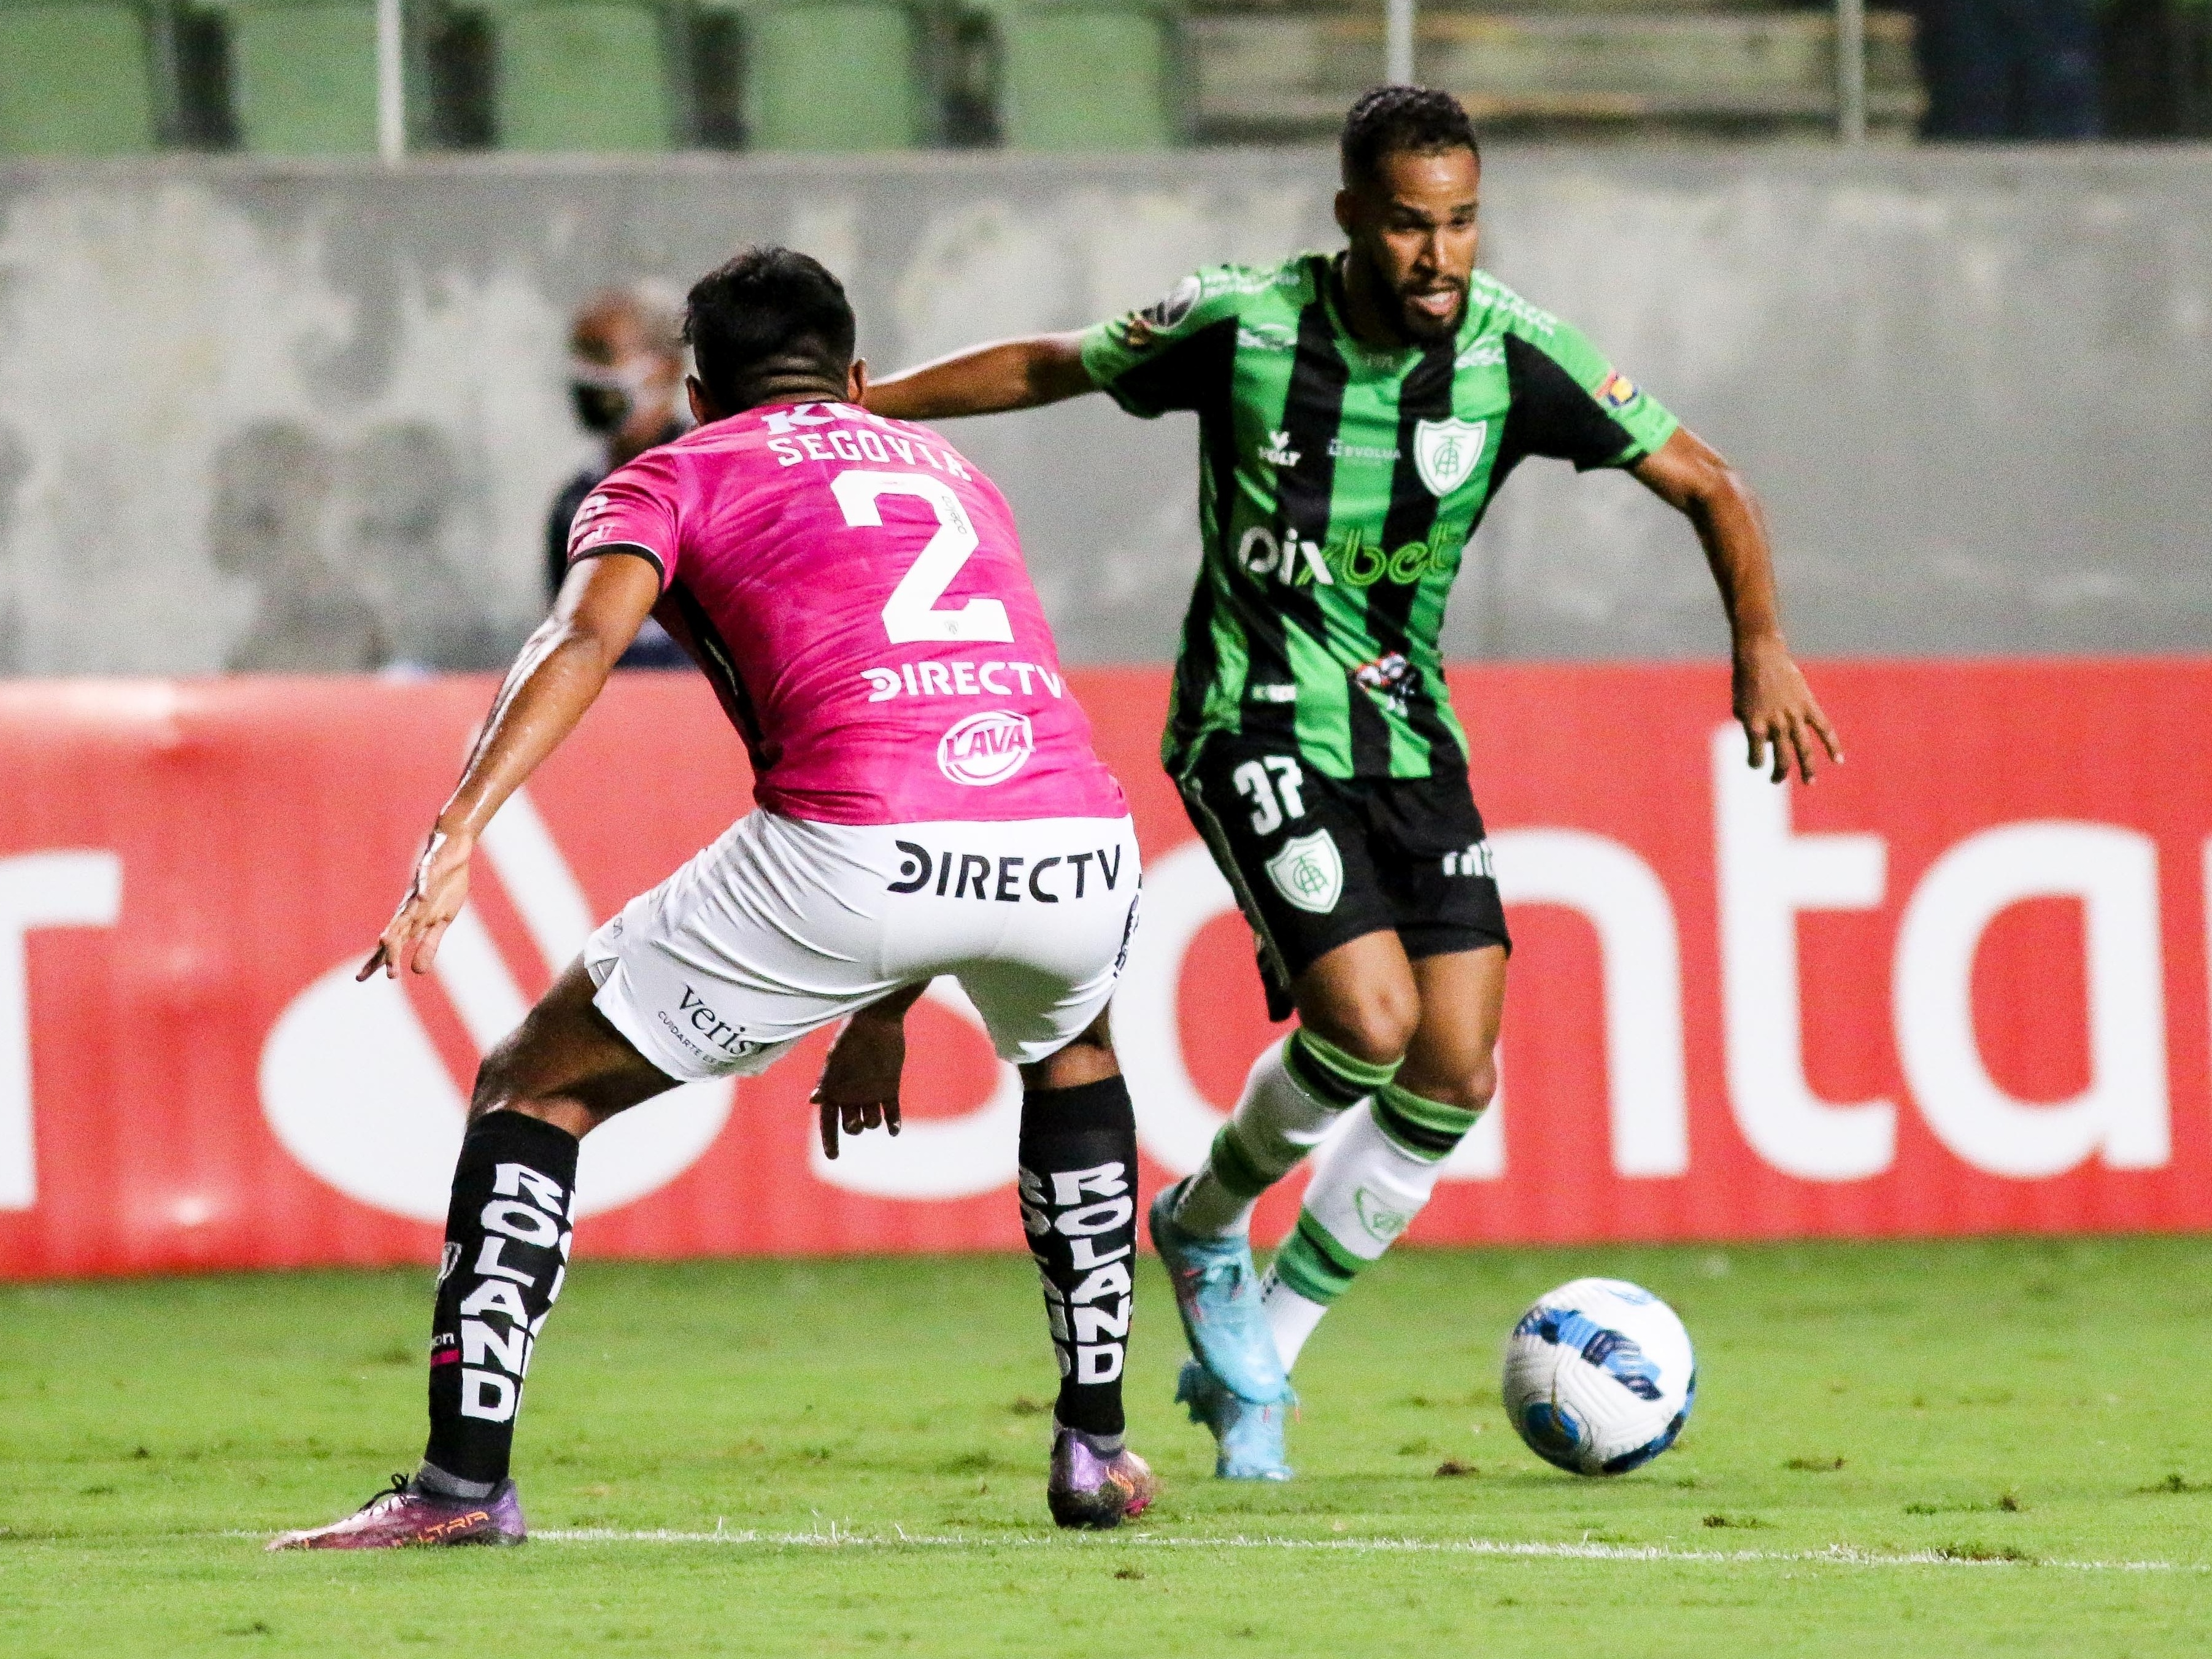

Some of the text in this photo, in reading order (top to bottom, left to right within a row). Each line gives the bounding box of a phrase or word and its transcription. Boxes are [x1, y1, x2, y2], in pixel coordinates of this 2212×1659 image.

[768, 430, 973, 482] SEGOVIA
[830, 469, 1015, 644] 2
[860, 660, 1062, 703] DIRECTV
[946, 724, 1032, 764] LAVA
[1231, 754, 1306, 836] 37
[887, 839, 1121, 903] DIRECTV
[460, 1162, 563, 1423] ROLAND
[1051, 1161, 1134, 1385] ROLAND
